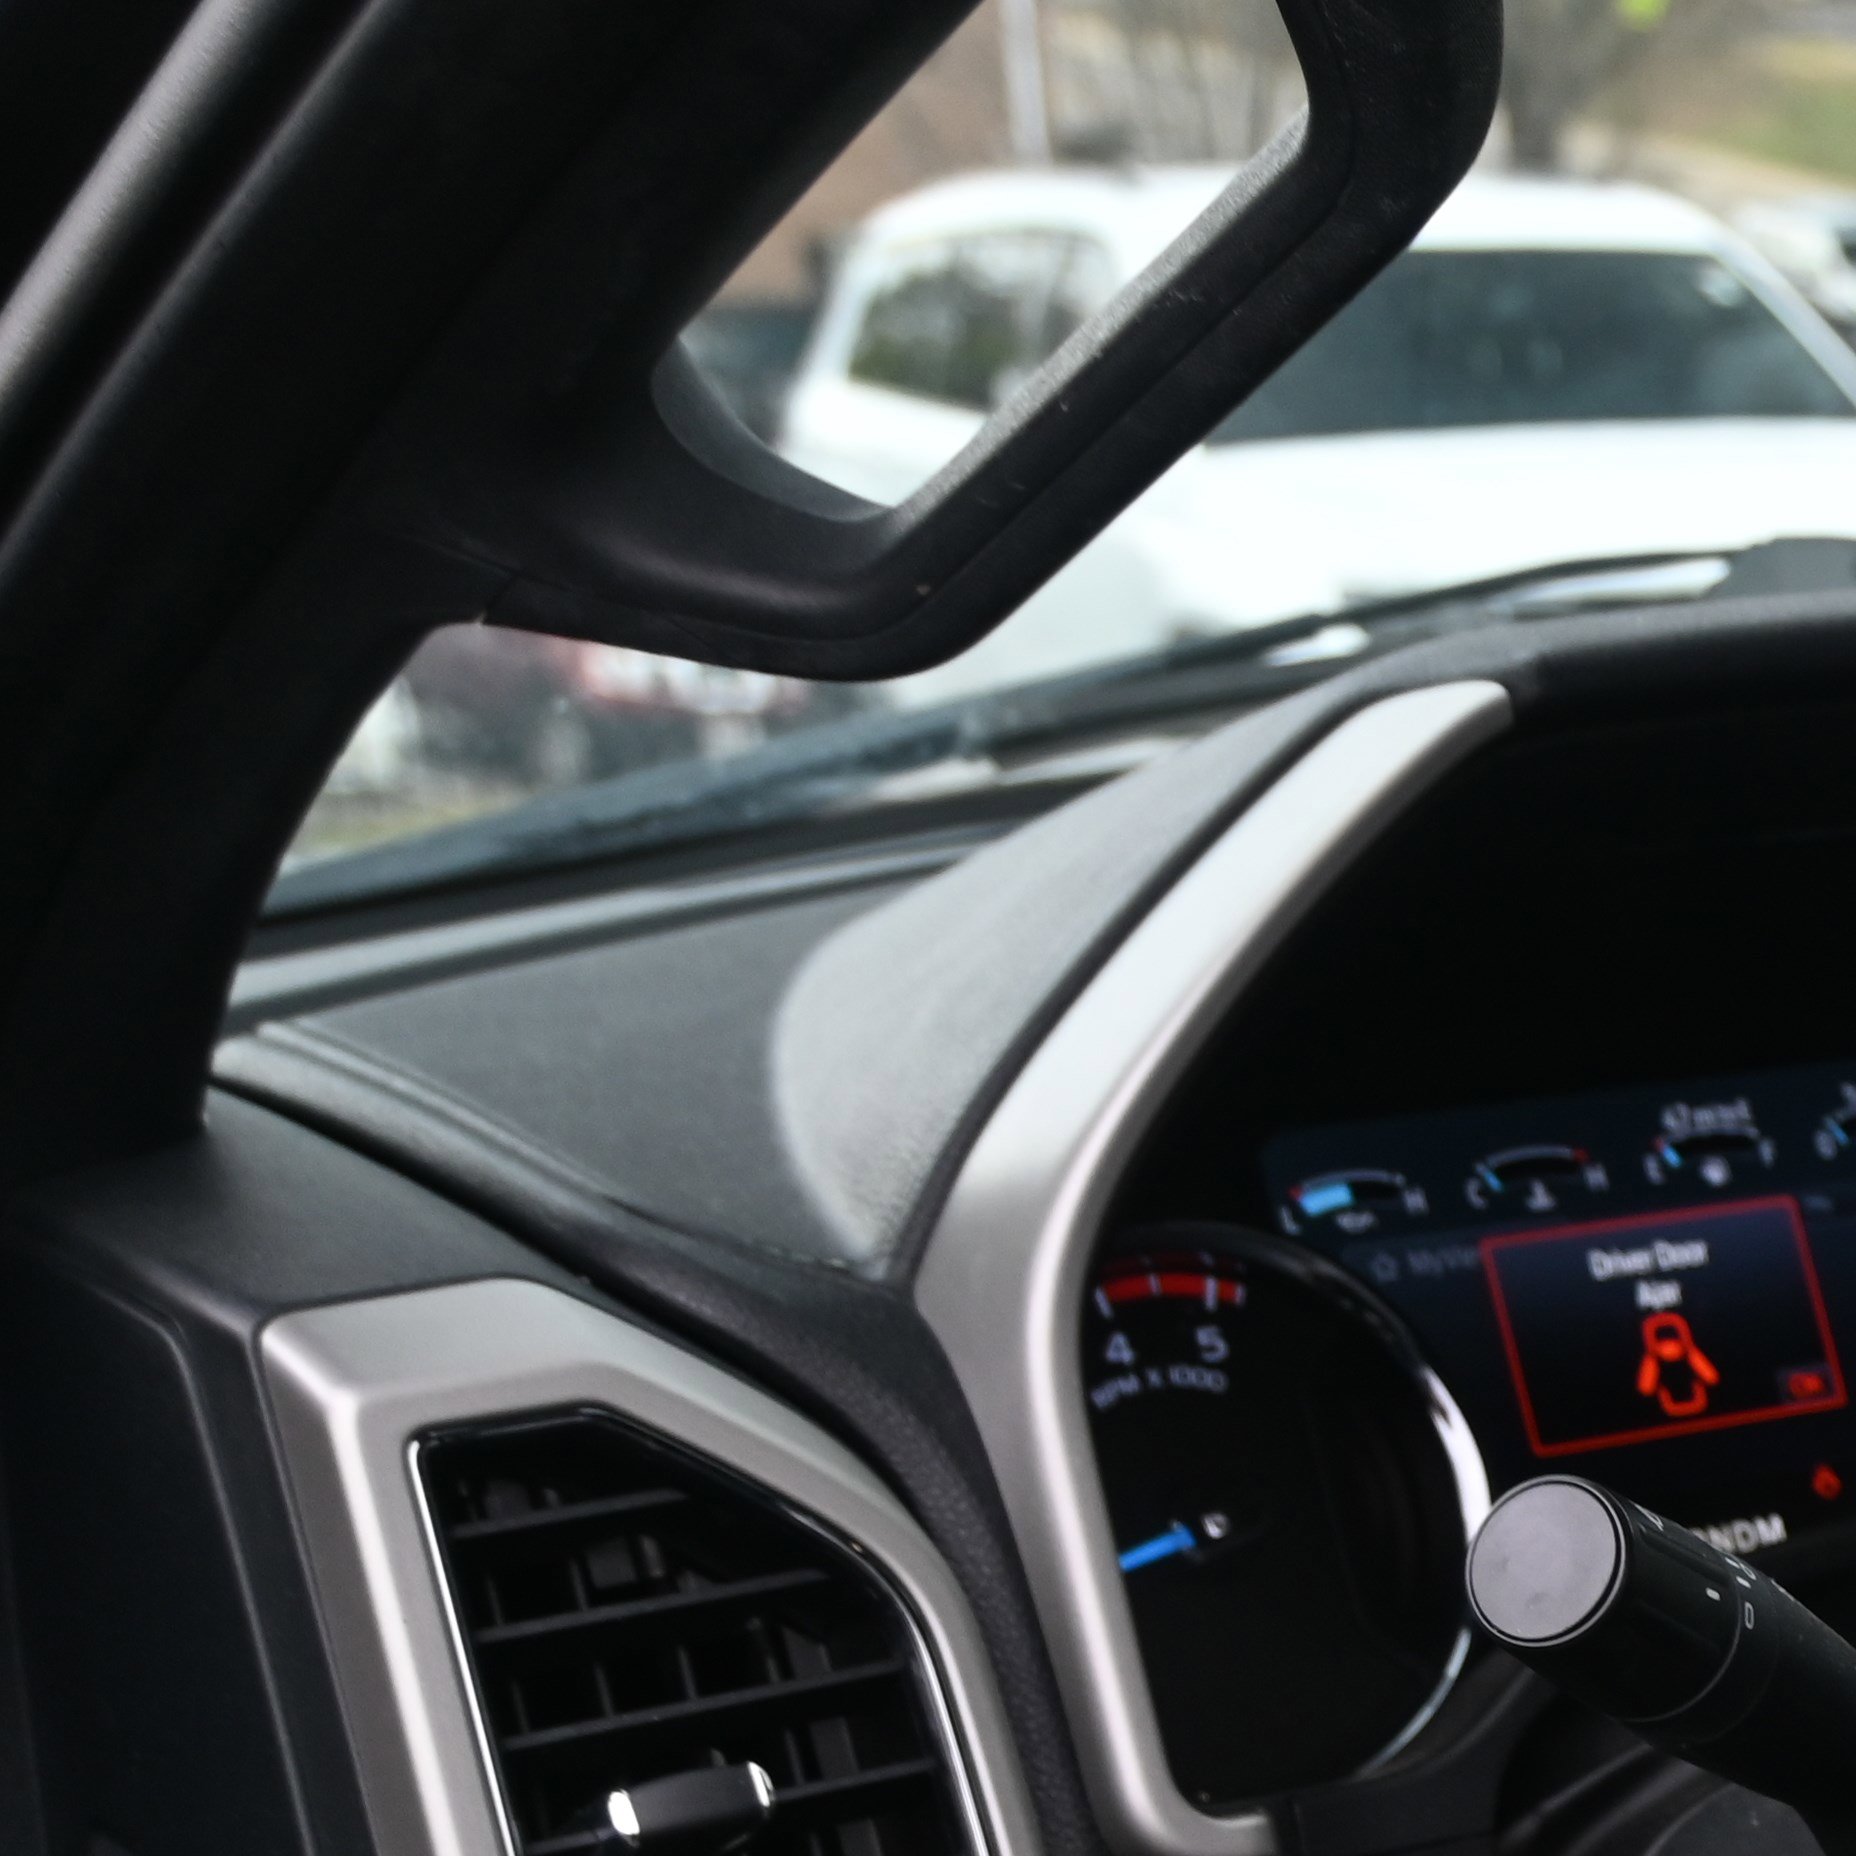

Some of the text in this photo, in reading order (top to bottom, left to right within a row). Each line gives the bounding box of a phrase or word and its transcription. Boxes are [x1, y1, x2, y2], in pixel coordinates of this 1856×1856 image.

[1105, 1331, 1135, 1366] 4
[1196, 1325, 1230, 1364] 5
[1168, 1364, 1228, 1394] 1000
